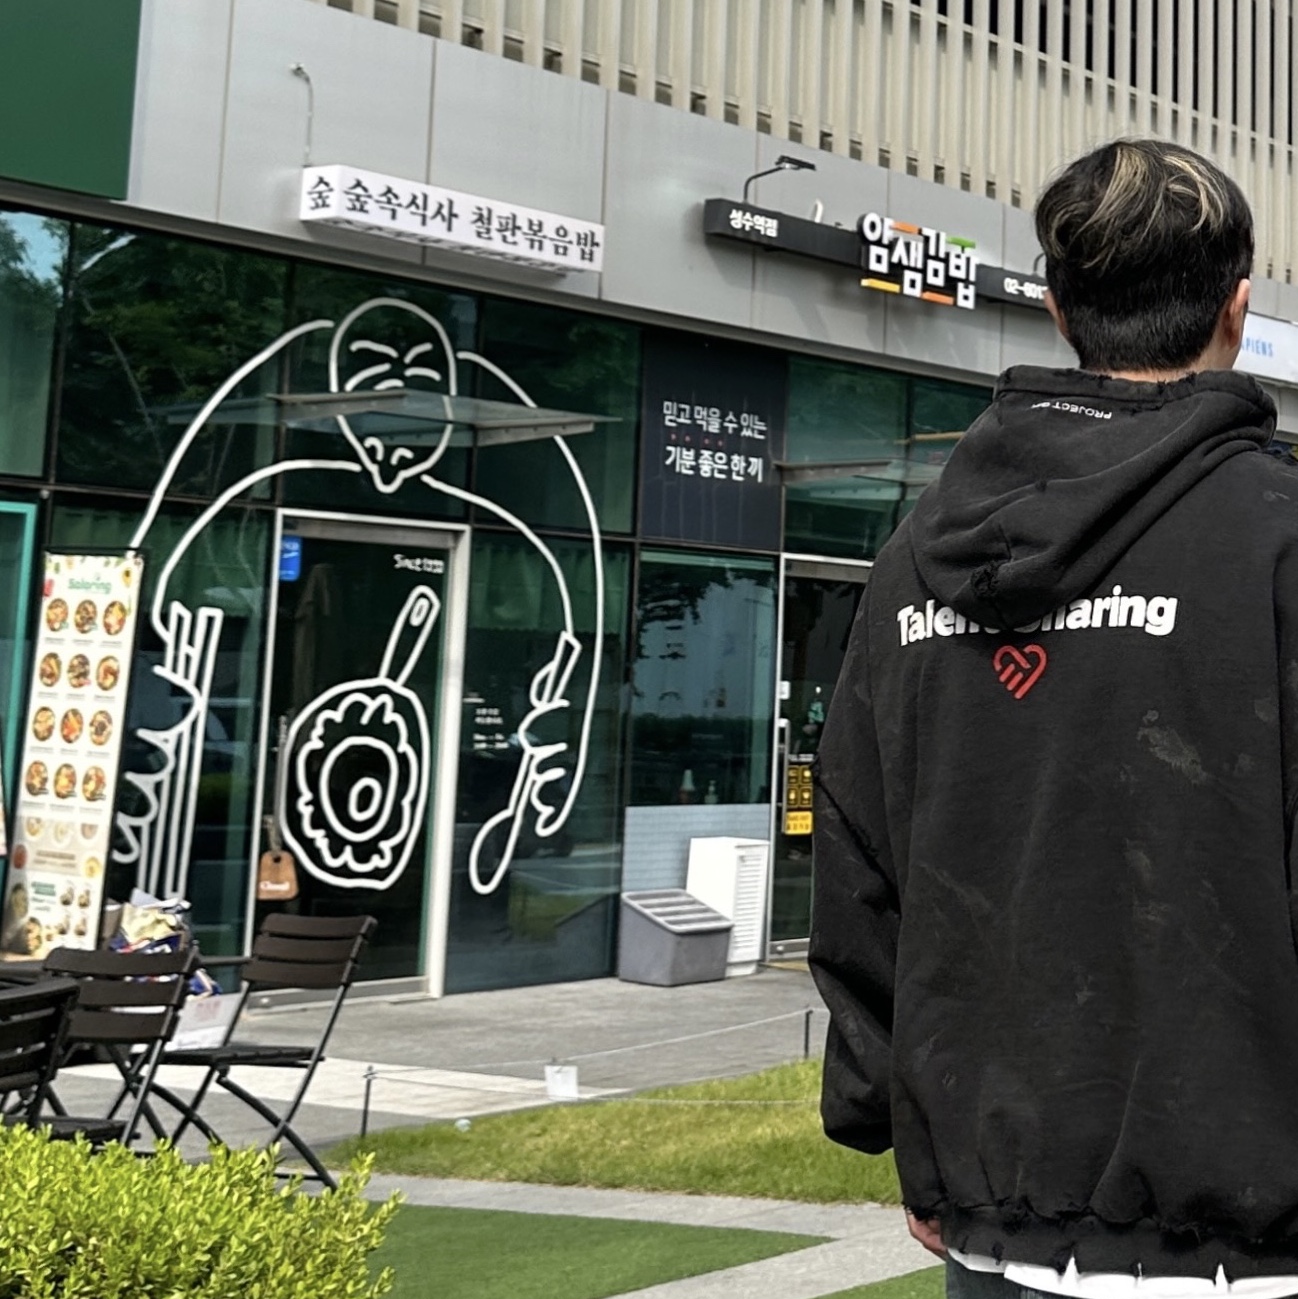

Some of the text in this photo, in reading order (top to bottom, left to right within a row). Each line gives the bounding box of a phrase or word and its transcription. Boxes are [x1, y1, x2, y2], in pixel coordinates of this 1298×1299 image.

[307, 176, 334, 211] 숲
[343, 178, 601, 263] 숲속식사 철판볶음밥
[729, 208, 779, 238] 성수역점
[862, 212, 977, 310] 얌샘김밥
[1242, 337, 1274, 358] PIENS
[663, 401, 768, 440] 믿고 먹을 수 있는
[1051, 401, 1113, 419] PROJECT
[665, 445, 696, 475] 기분
[698, 449, 729, 479] 좋은
[897, 584, 1178, 646] Talen haring
